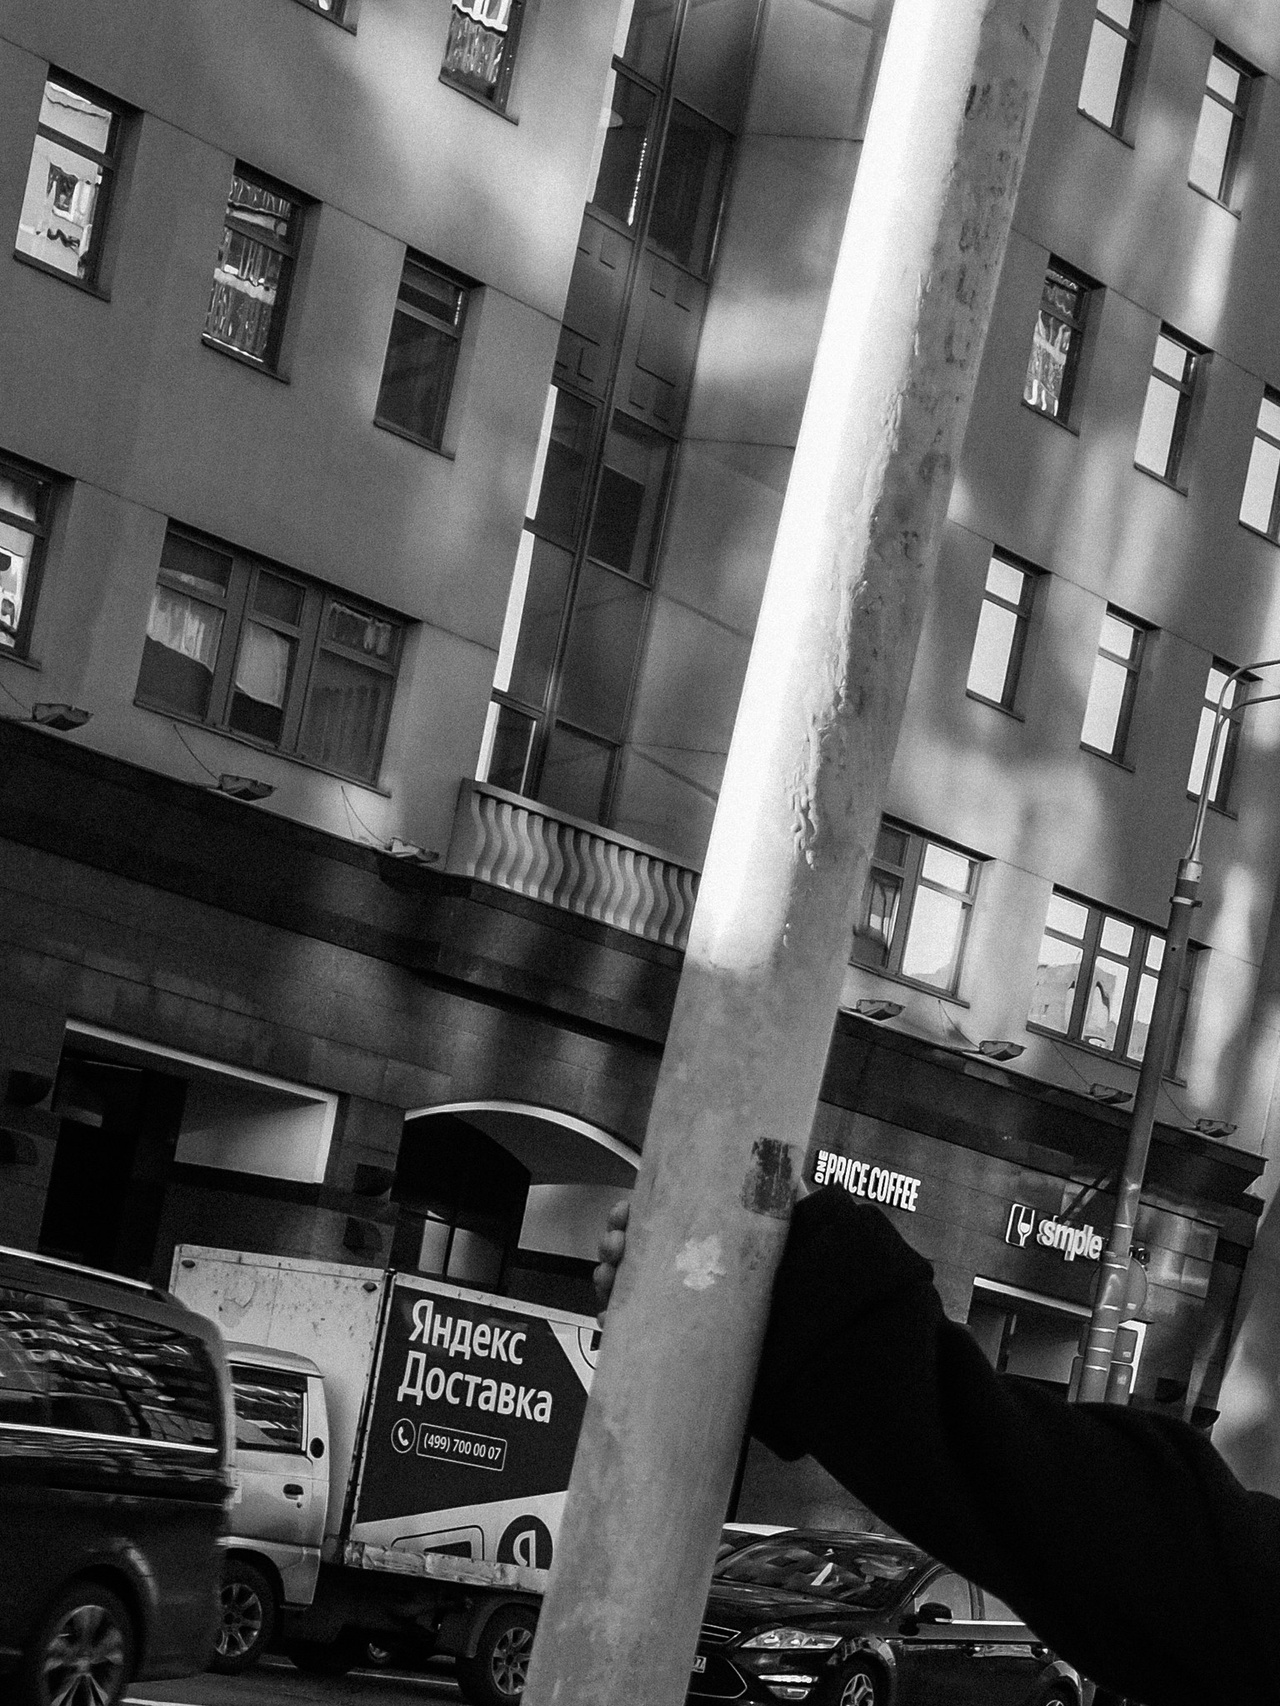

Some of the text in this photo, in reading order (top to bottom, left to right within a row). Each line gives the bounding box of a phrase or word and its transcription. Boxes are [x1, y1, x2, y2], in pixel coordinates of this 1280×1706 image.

[814, 1149, 922, 1212] ONE PRICE COFFEE
[408, 1299, 527, 1366] Яндекс
[396, 1350, 553, 1424] Доставка
[423, 1432, 502, 1460] (499) 700 00 07
